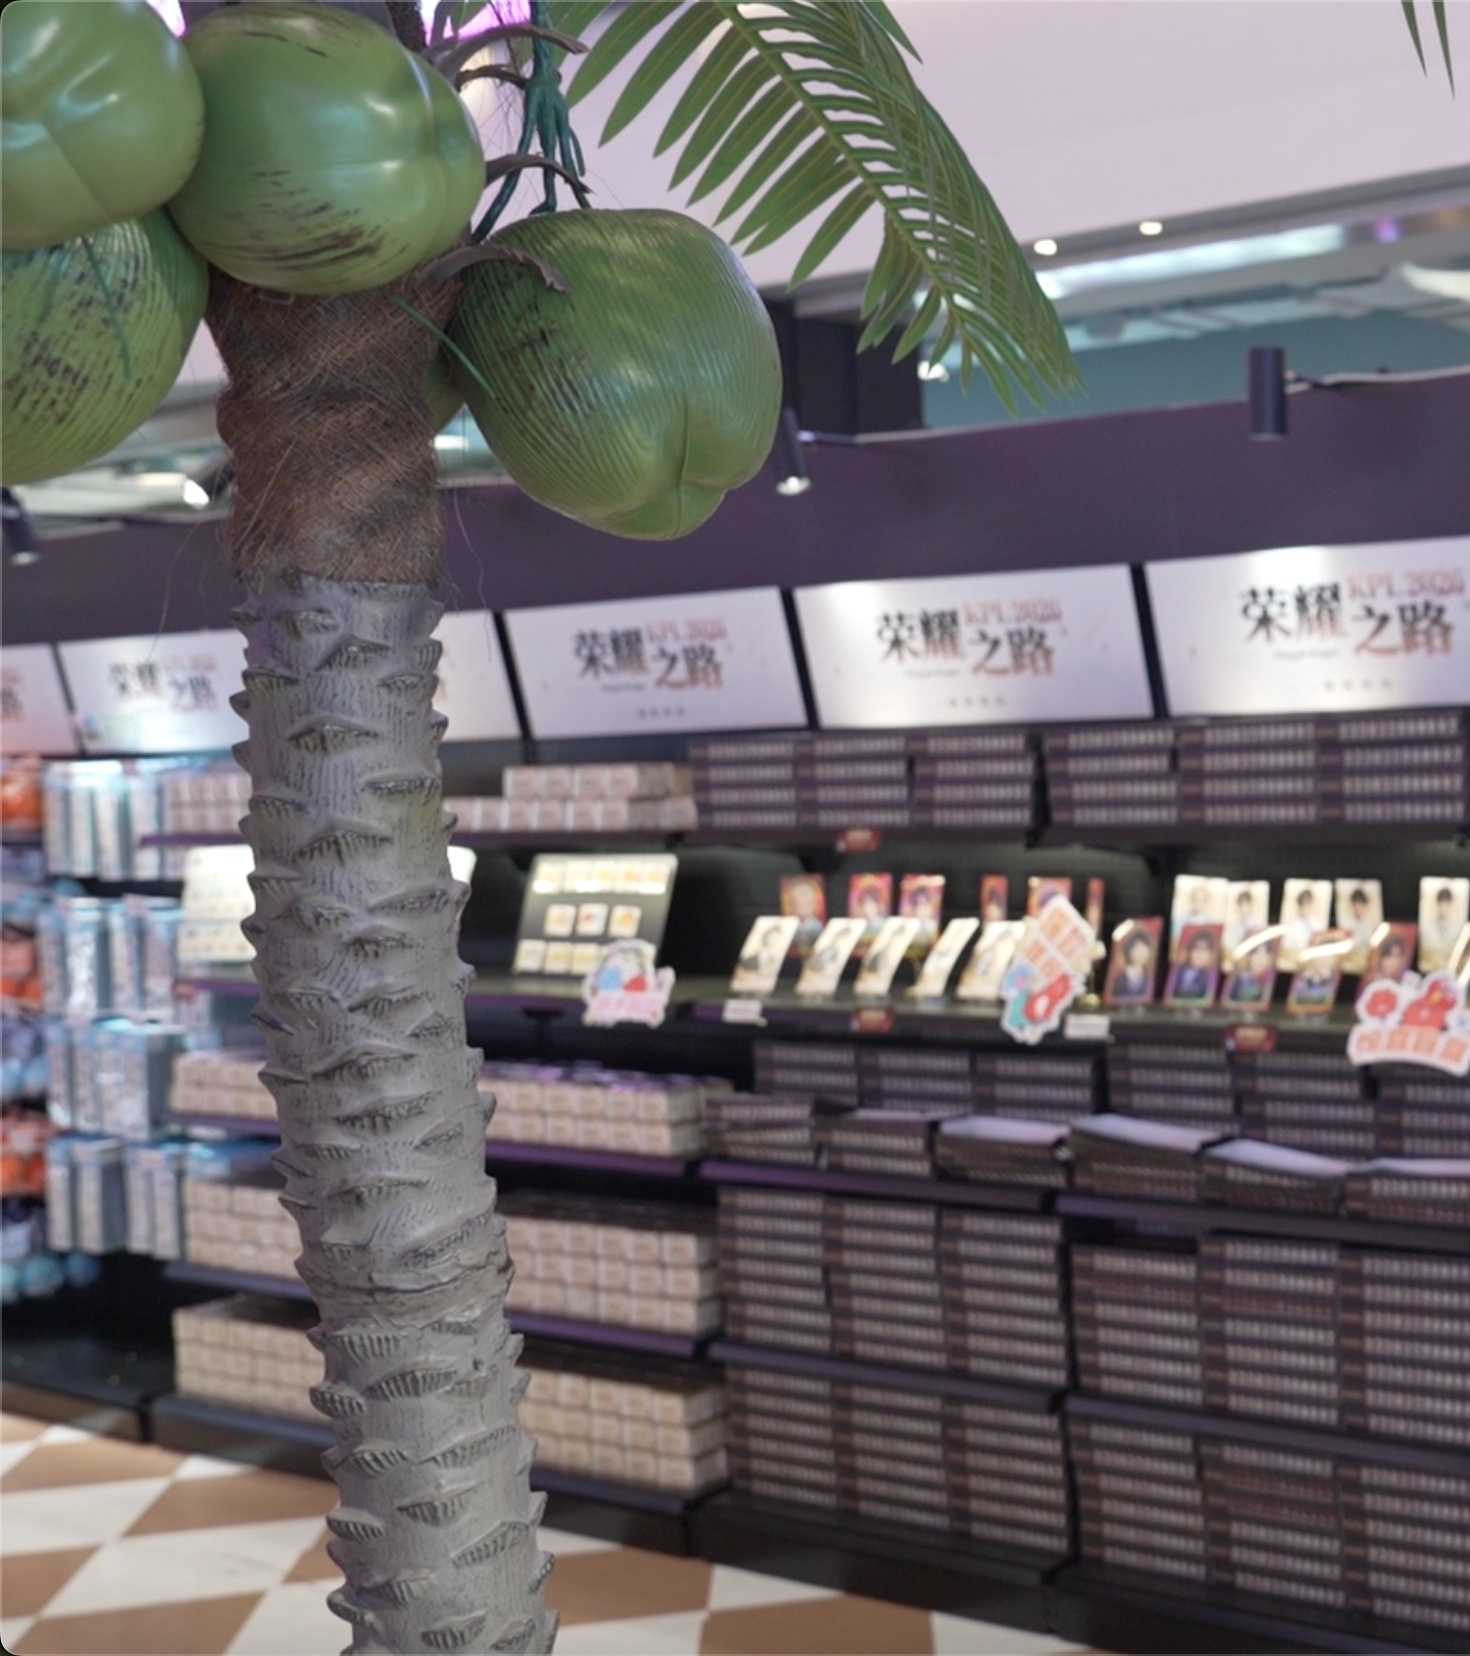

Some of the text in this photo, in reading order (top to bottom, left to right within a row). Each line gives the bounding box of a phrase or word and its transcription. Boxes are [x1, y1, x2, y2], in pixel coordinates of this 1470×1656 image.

[877, 608, 1055, 676] 荣耀之路
[1240, 582, 1455, 656] 荣耀之路
[574, 626, 723, 690] 荣耀之路
